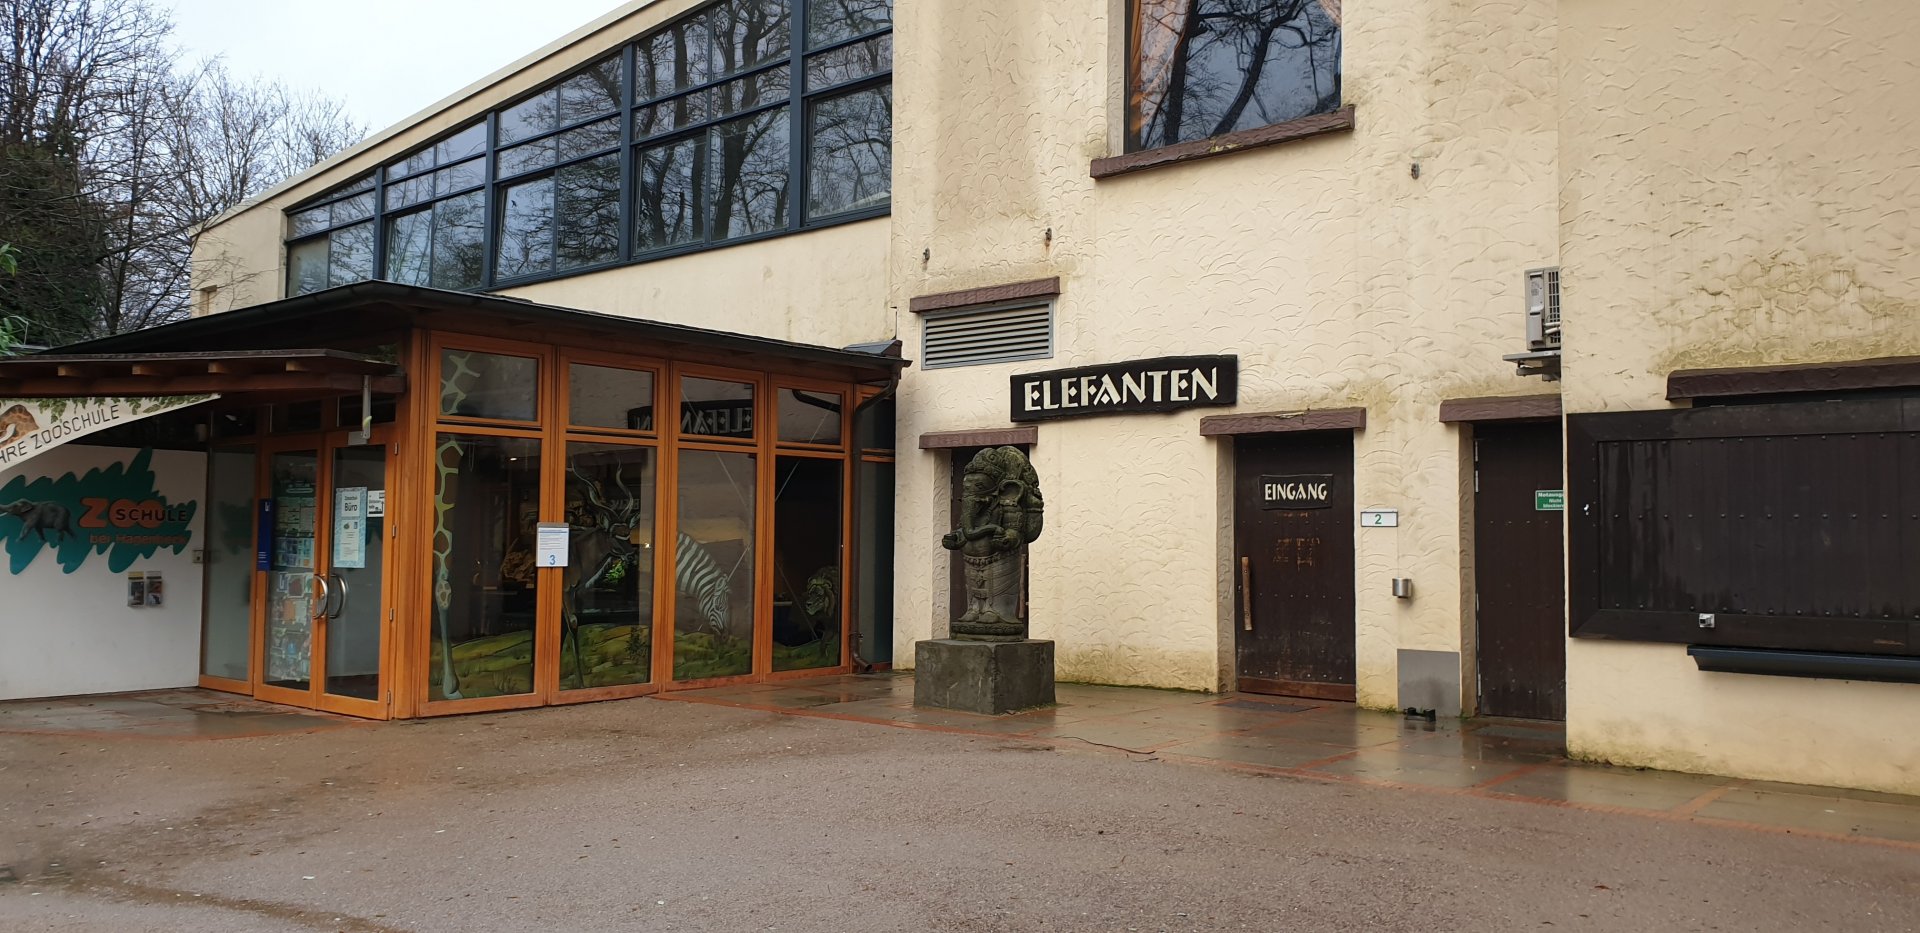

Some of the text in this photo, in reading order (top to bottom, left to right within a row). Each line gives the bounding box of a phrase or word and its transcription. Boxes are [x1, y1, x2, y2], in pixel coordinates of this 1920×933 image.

[1025, 367, 1218, 412] ELEFANTEN
[31, 405, 120, 450] ZOOSCHULE
[1264, 483, 1328, 501] EINGANG
[78, 497, 189, 529] ZOO SCHULE
[344, 502, 358, 512] Büro
[1374, 513, 1382, 524] 2
[549, 554, 556, 565] 3
